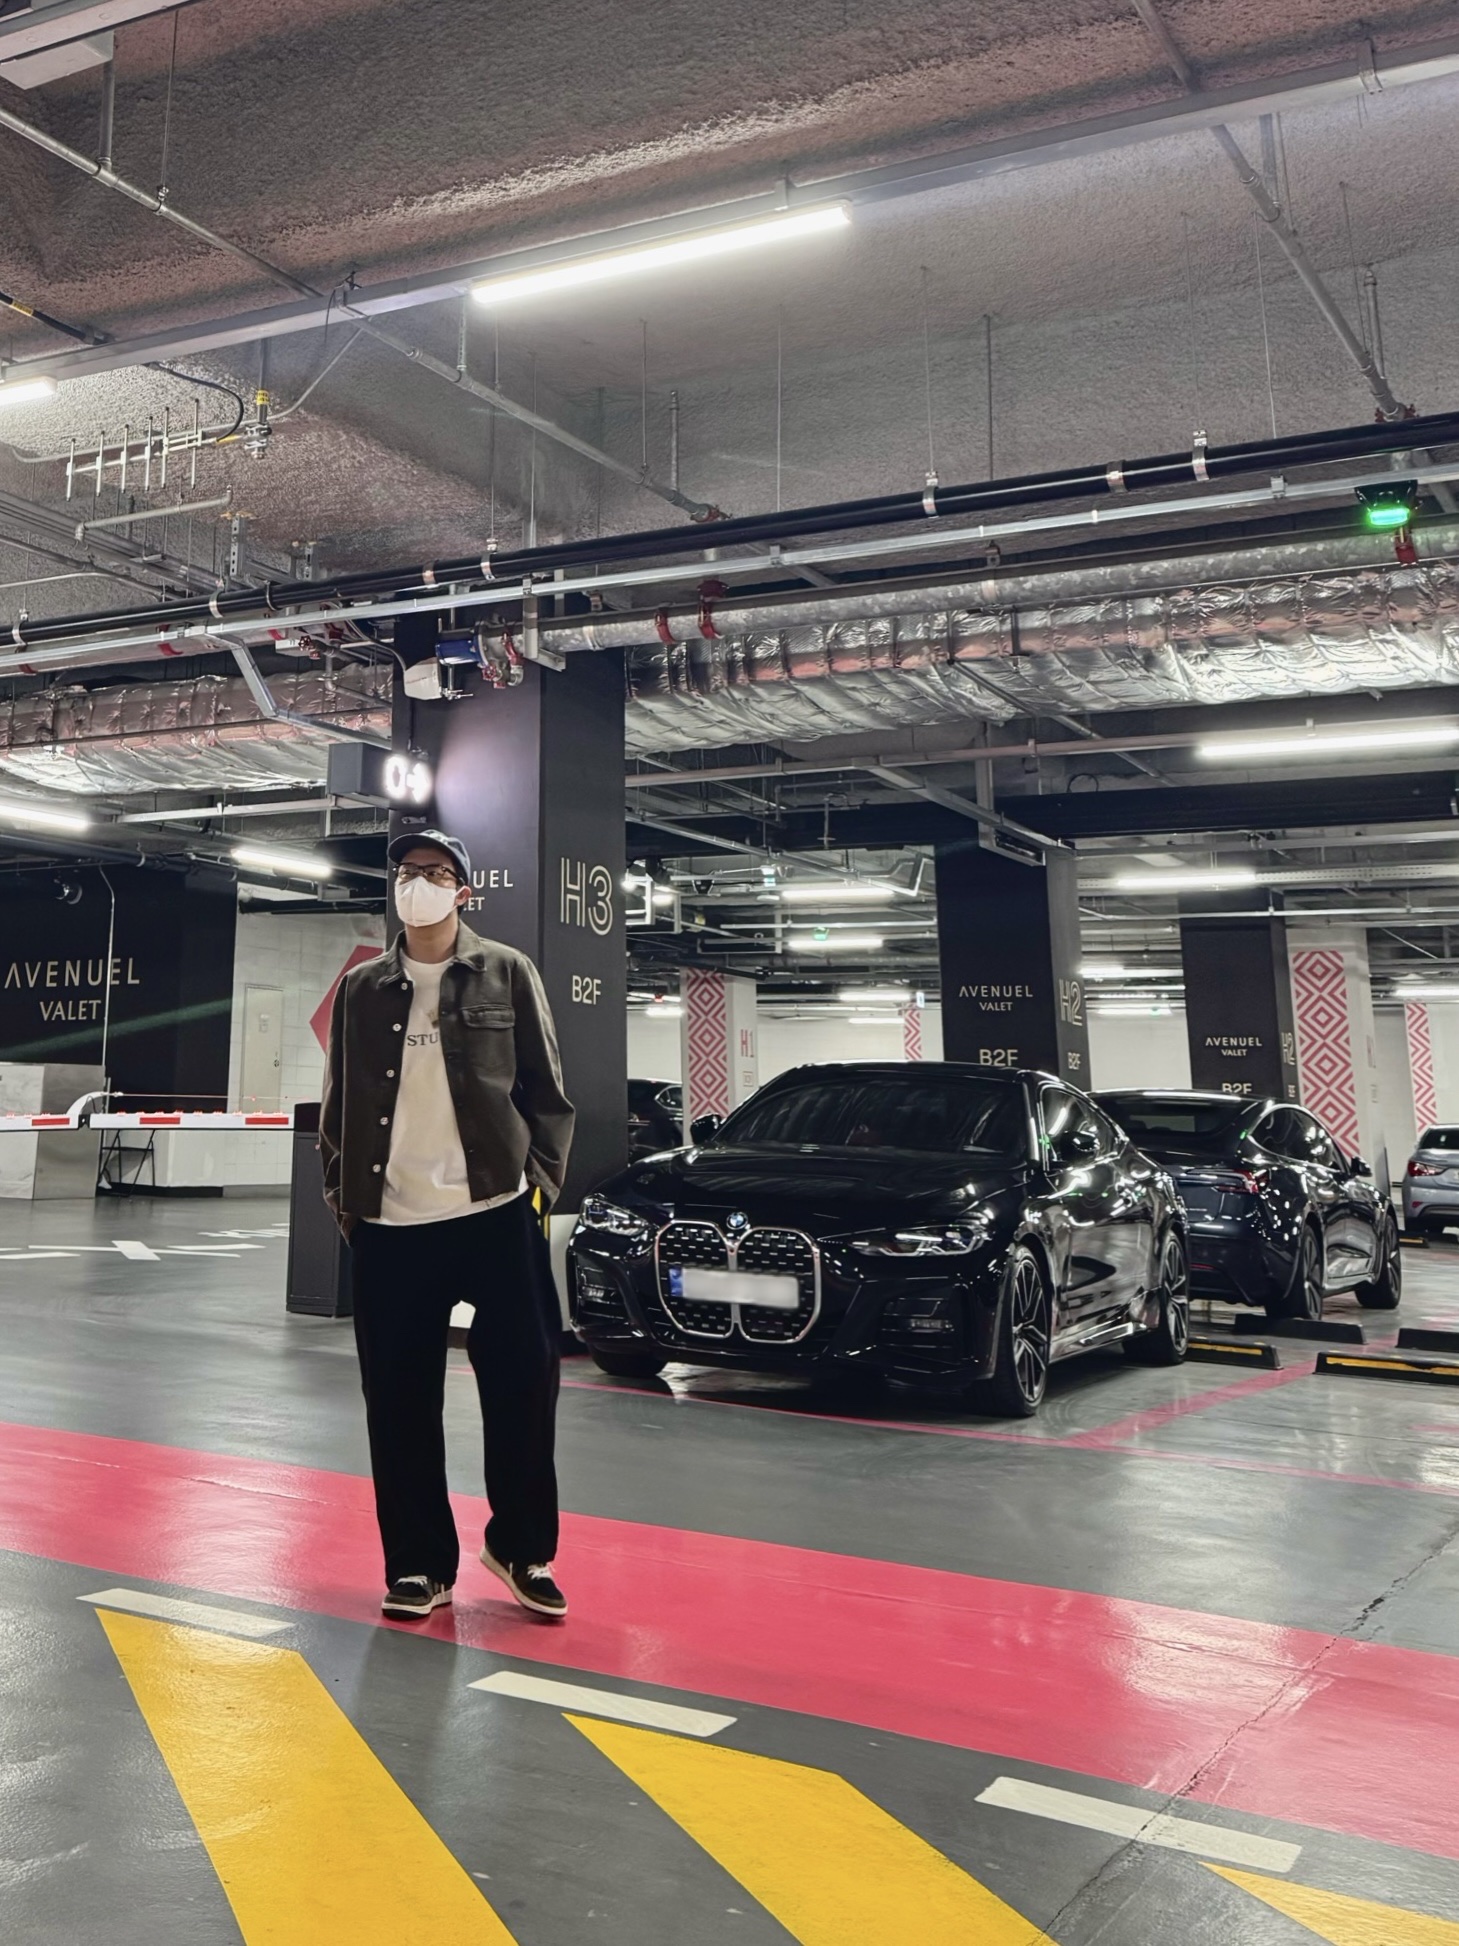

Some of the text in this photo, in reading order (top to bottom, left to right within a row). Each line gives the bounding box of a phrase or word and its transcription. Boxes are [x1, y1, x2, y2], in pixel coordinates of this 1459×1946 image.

[560, 857, 613, 936] H3
[4, 957, 140, 989] AVENUEL
[572, 974, 602, 1005] B2F
[959, 985, 1034, 998] AVENUEL
[39, 999, 102, 1021] VALET
[979, 1001, 1014, 1012] VALET
[1058, 979, 1083, 1027] H2
[1205, 1036, 1263, 1047] AVENUEL
[979, 1048, 1018, 1067] B2F
[1221, 1048, 1248, 1057] VALET
